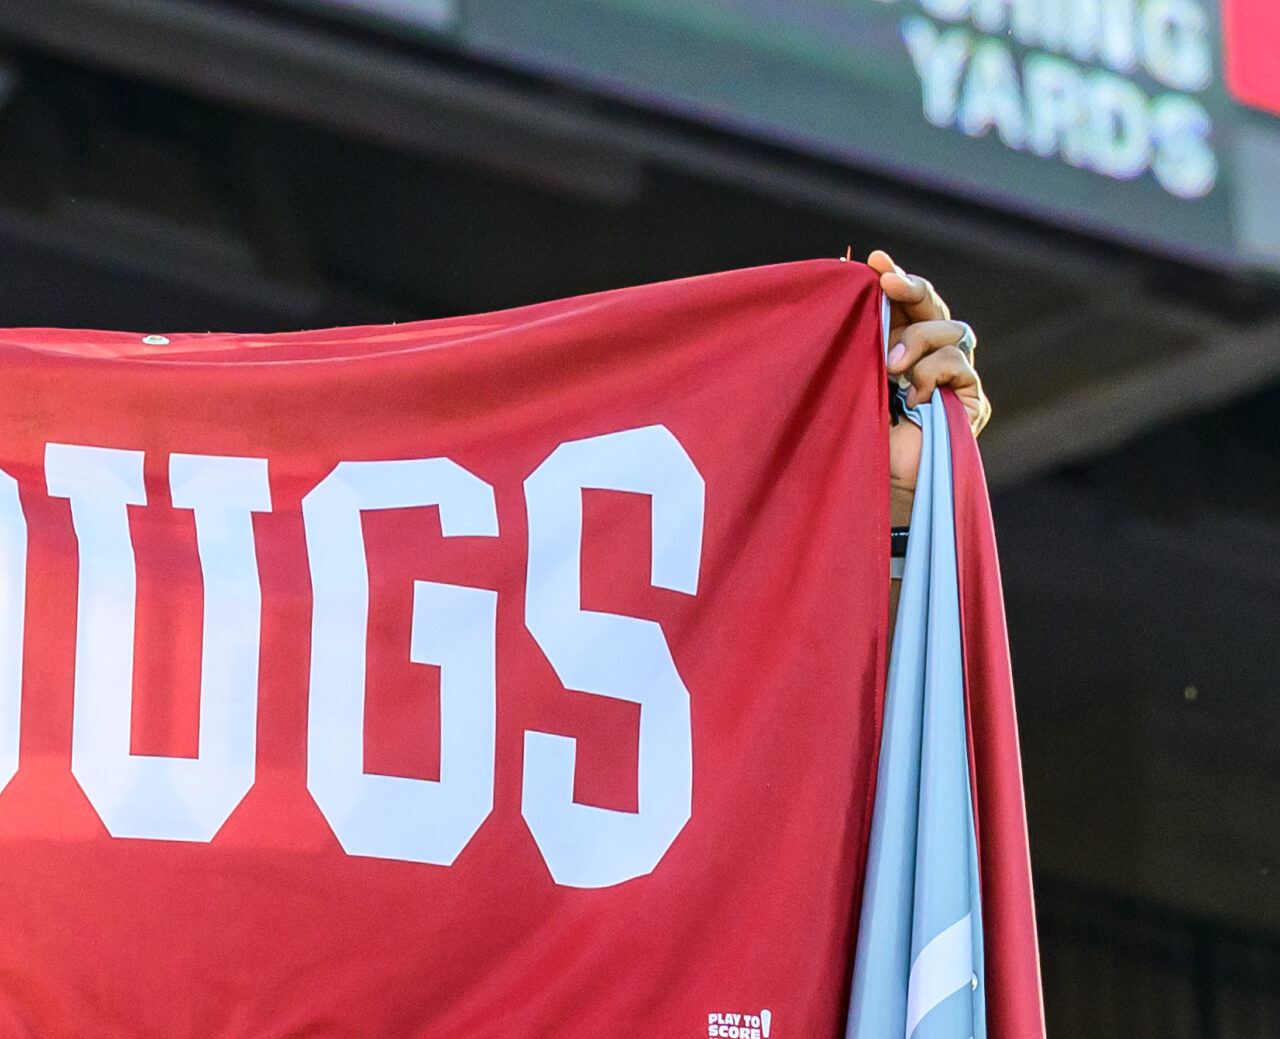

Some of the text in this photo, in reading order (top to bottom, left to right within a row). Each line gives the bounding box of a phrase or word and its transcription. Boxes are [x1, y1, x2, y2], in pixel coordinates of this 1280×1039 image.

[900, 14, 1216, 198] YARDS
[708, 1013, 761, 1028] PLAY TO
